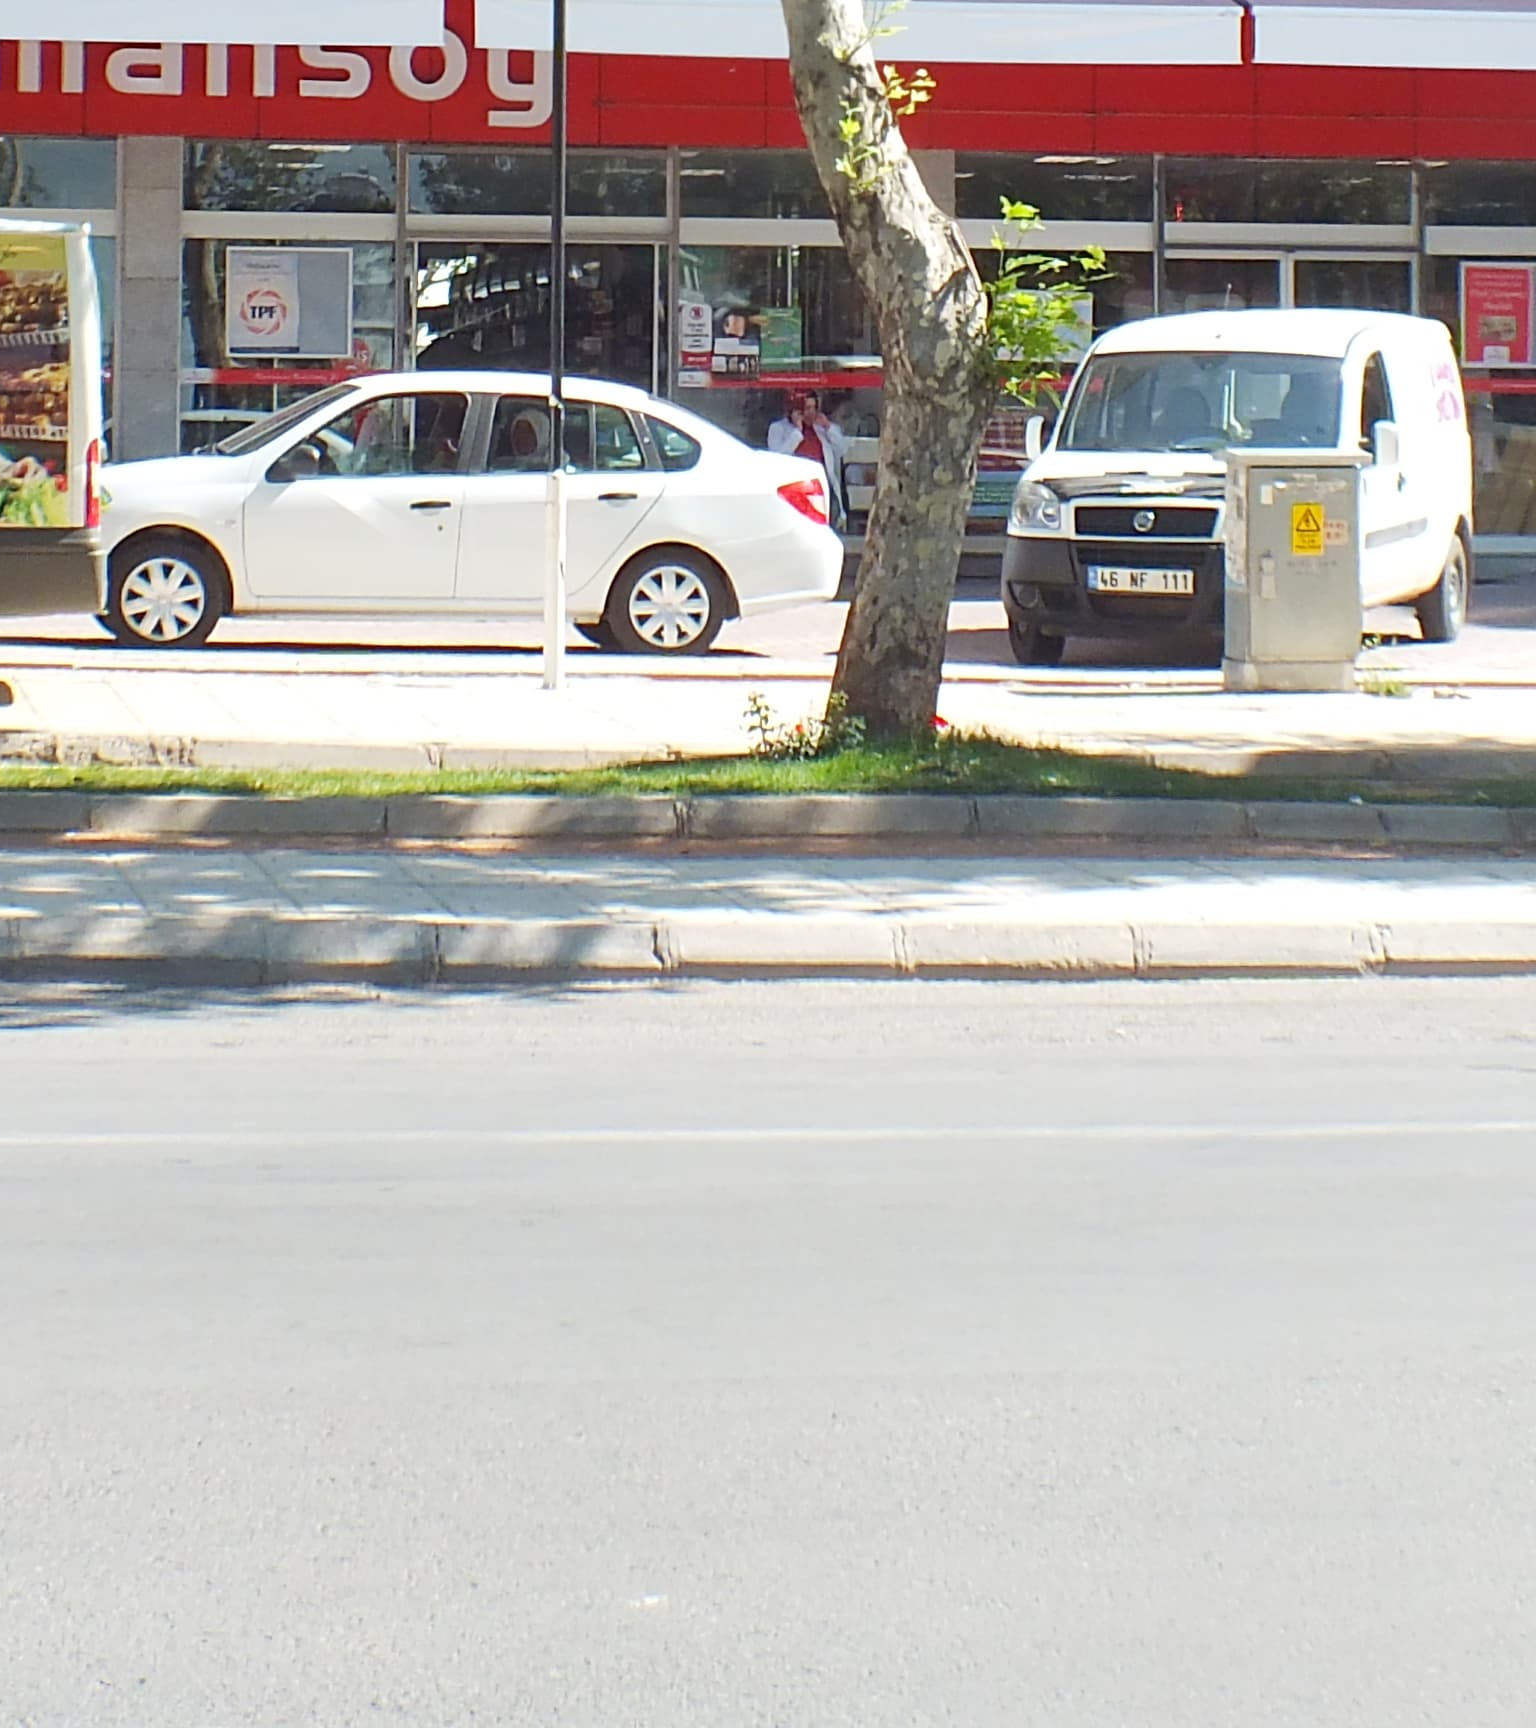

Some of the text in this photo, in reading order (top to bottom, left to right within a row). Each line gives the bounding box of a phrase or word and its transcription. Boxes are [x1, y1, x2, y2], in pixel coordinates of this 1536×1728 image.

[250, 305, 278, 319] TPF
[1100, 571, 1189, 591] 46 NF 111
